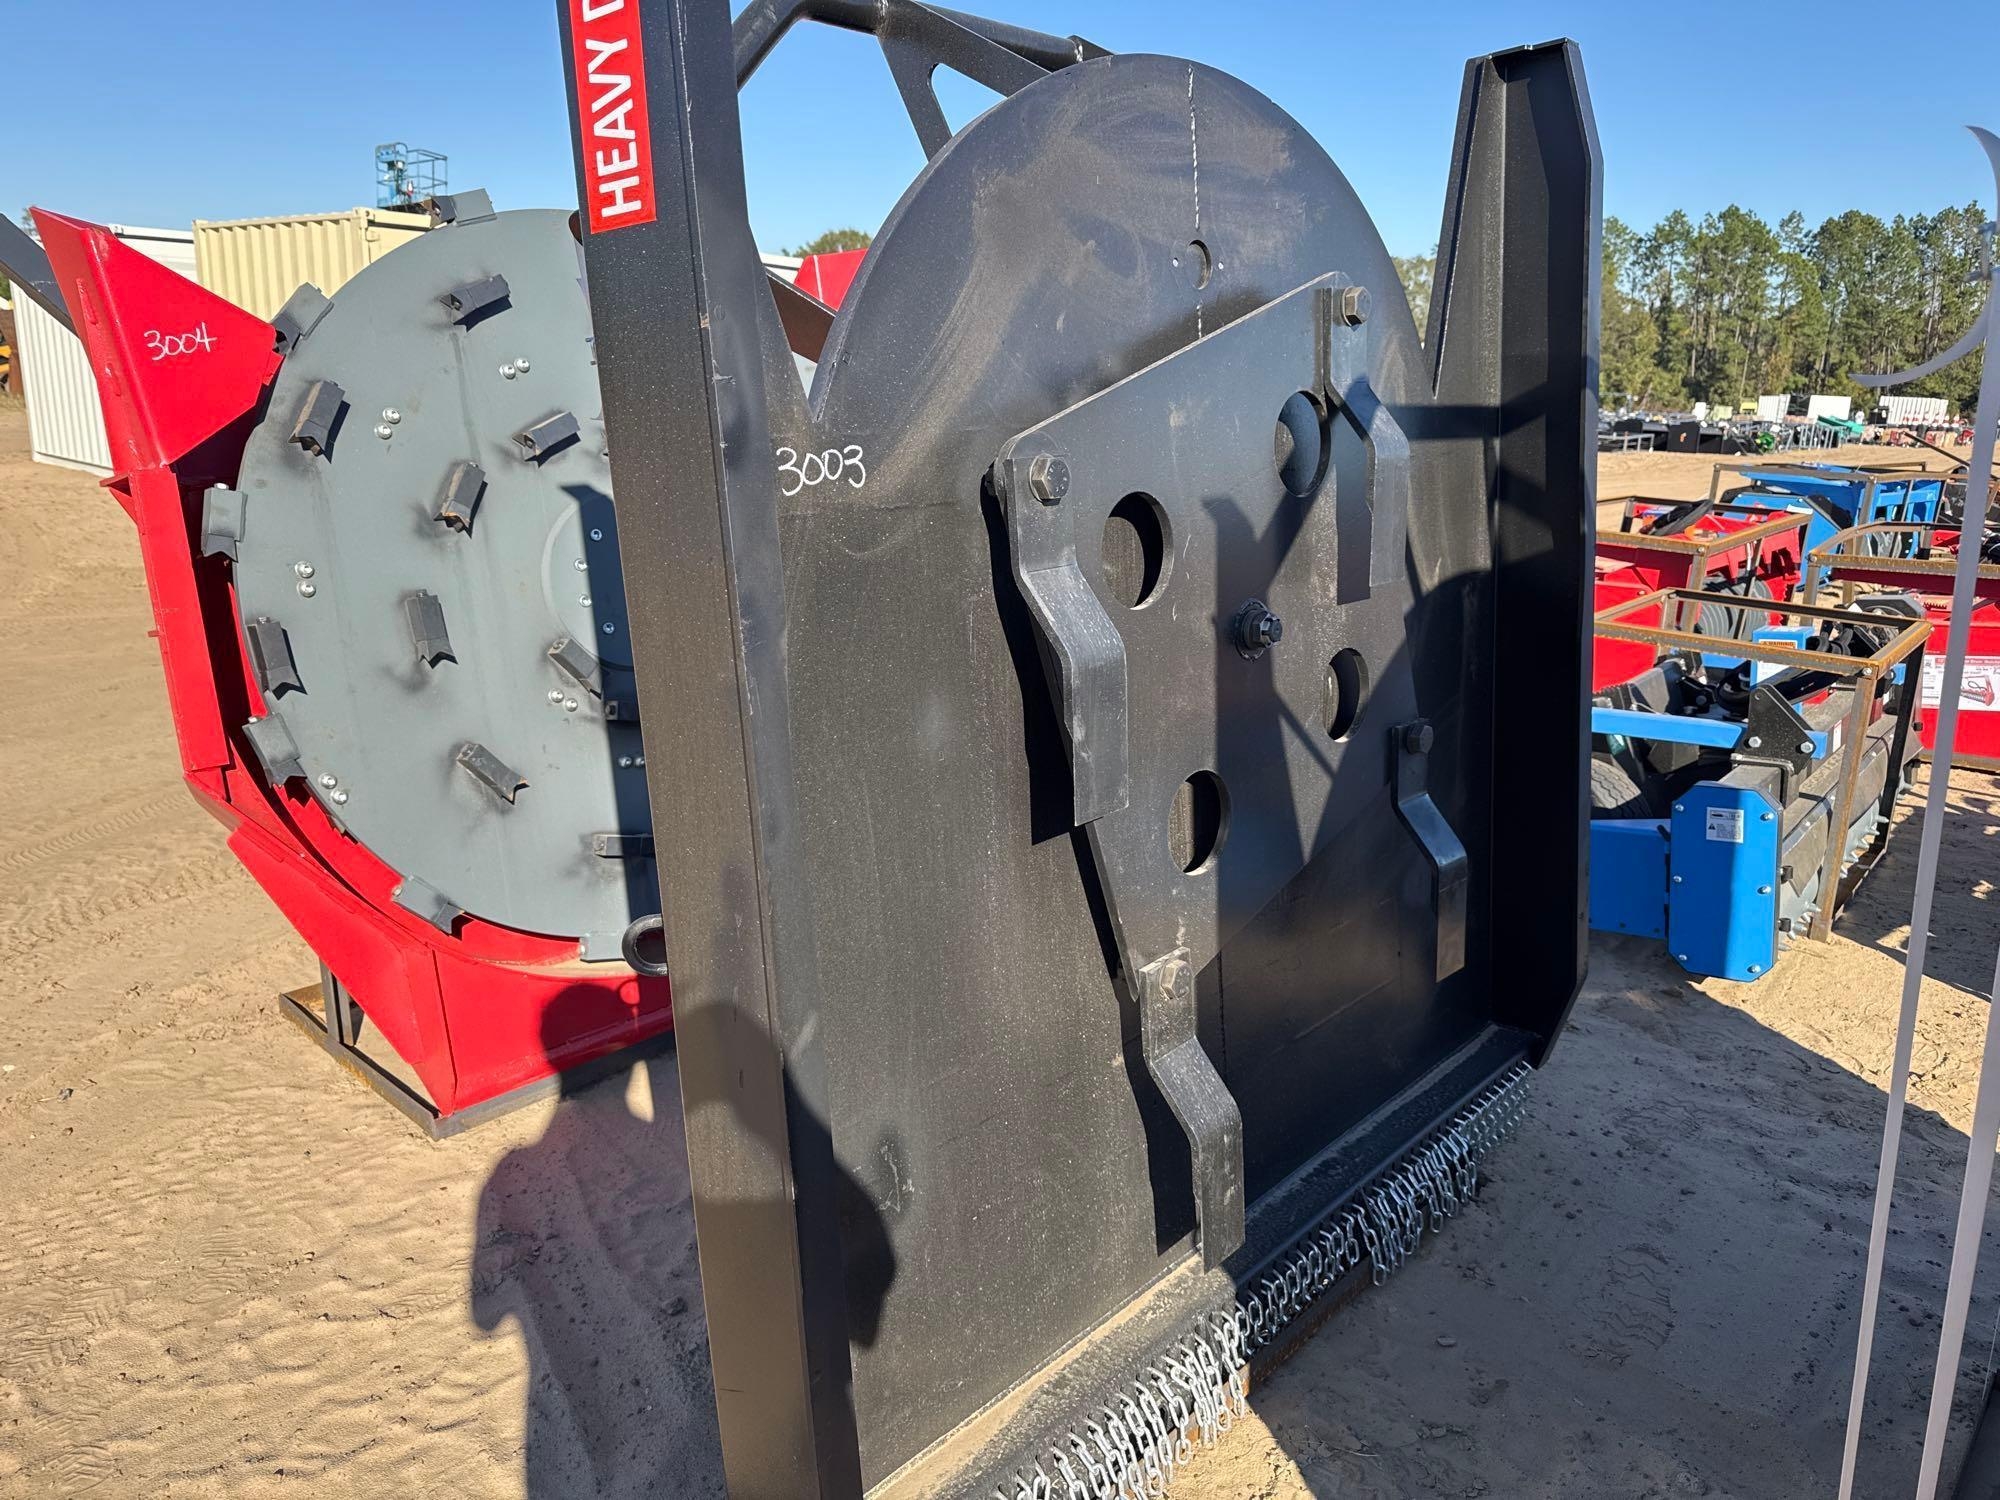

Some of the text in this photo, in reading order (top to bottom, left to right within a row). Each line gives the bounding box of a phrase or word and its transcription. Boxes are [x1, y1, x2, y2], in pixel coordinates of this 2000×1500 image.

[585, 38, 642, 218] HEAVY
[143, 321, 218, 361] 3004
[776, 444, 866, 497] 3003
